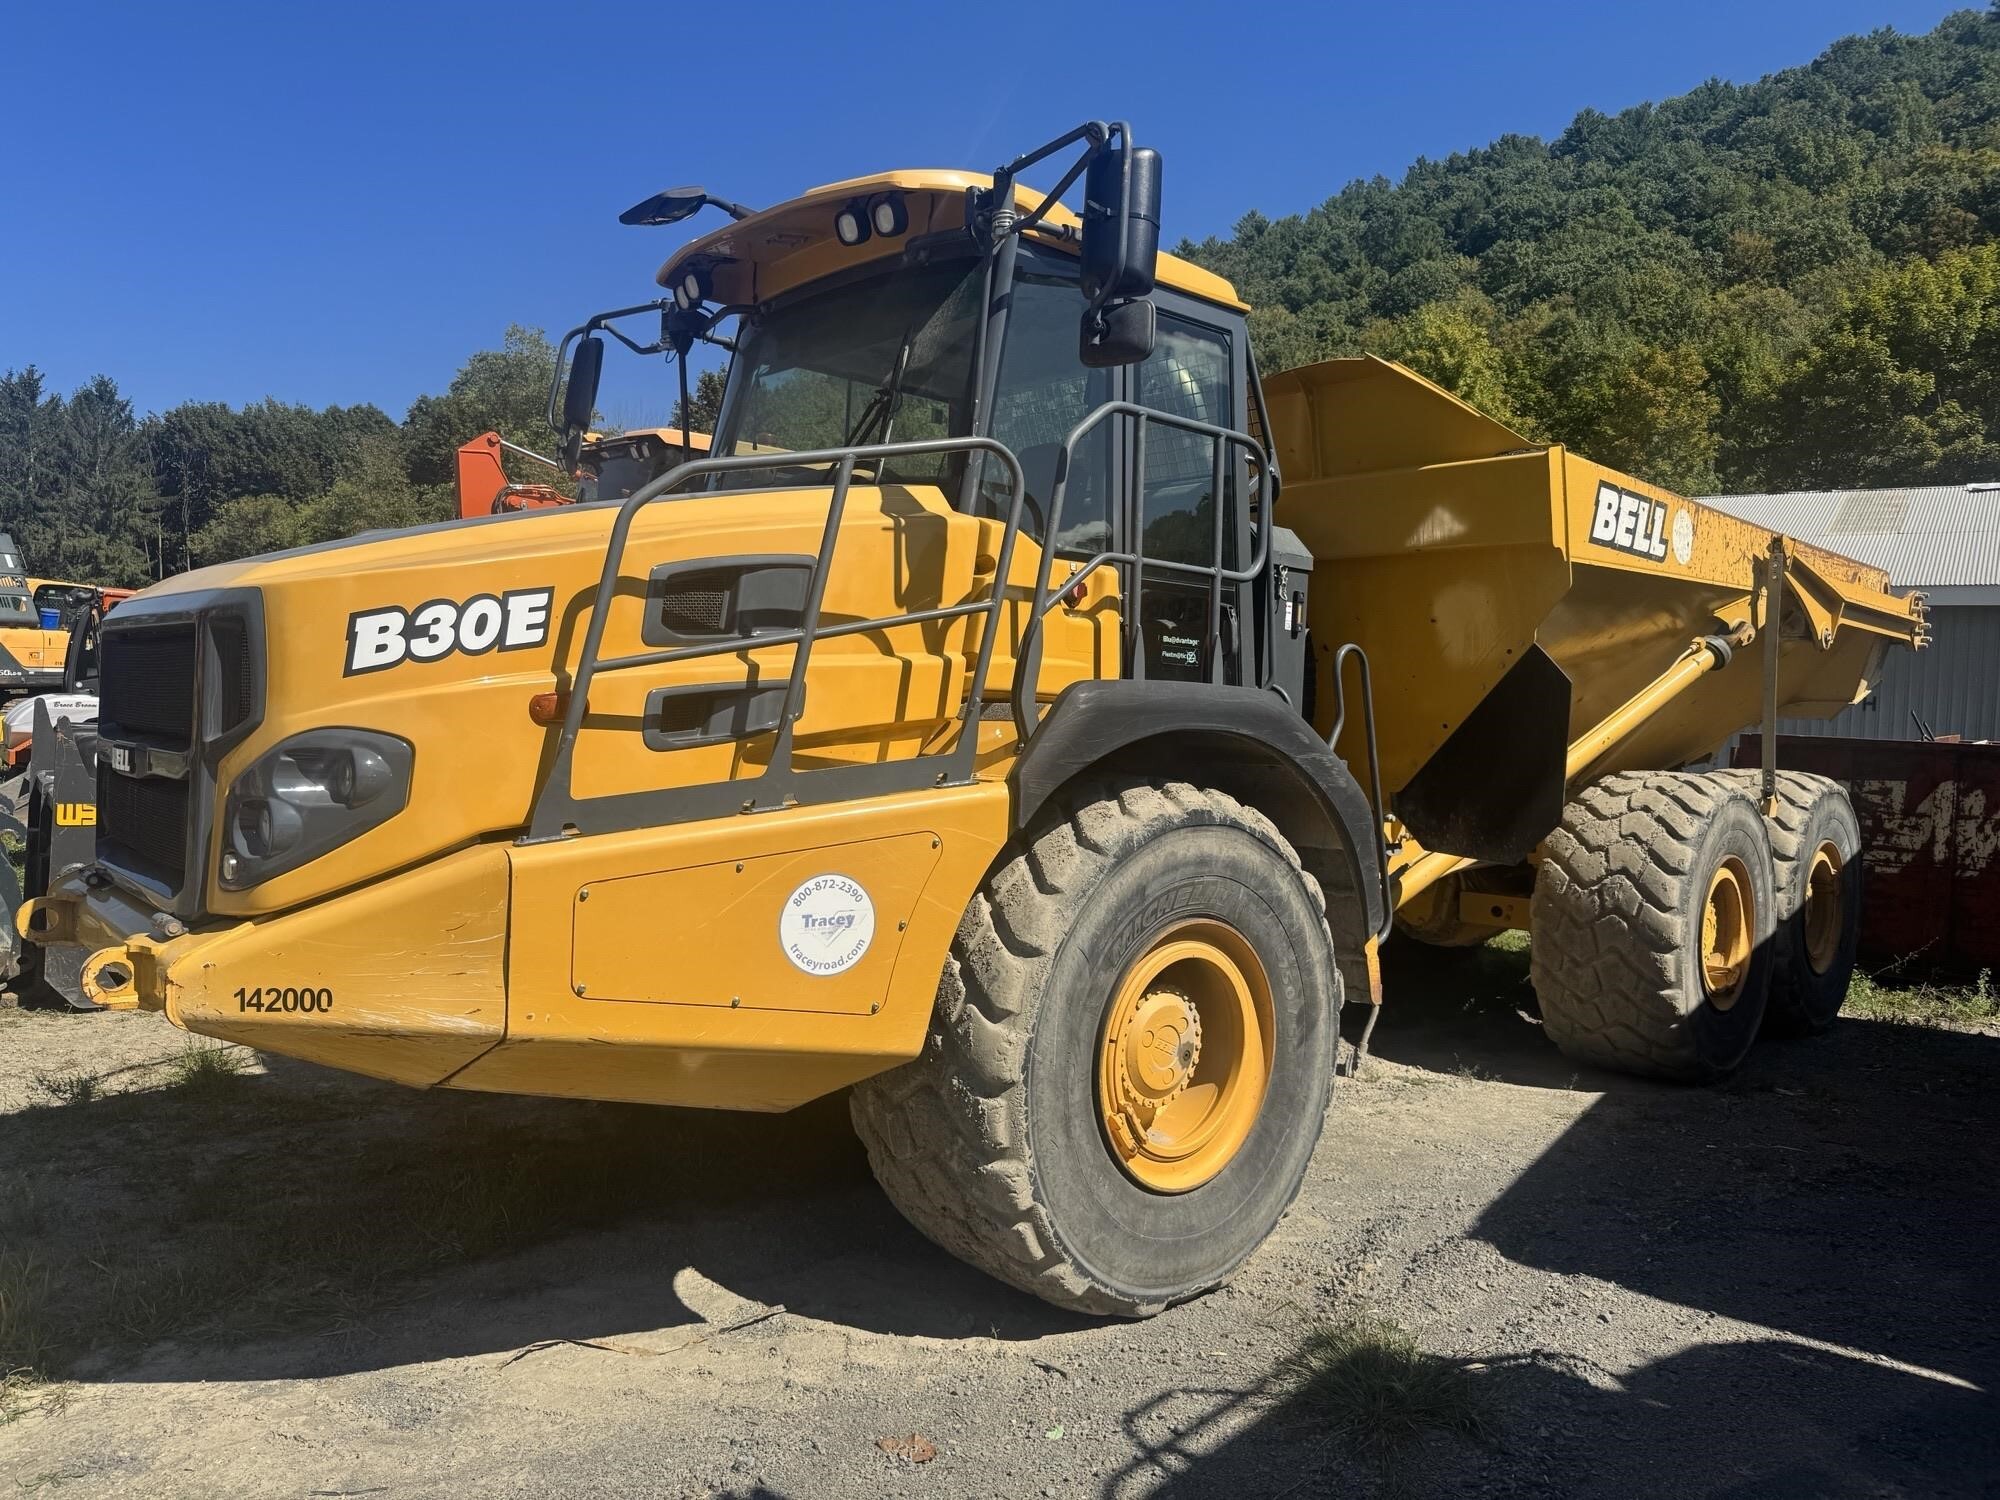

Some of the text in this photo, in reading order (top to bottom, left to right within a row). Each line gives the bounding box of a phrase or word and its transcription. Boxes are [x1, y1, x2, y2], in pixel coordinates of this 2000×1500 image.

[1589, 481, 1668, 563] BELL
[344, 588, 554, 677] B30E
[792, 879, 864, 908] 800-872-2390
[801, 914, 856, 929] Tracey
[790, 938, 866, 971] traceyroad.com
[233, 987, 333, 1013] 142000
